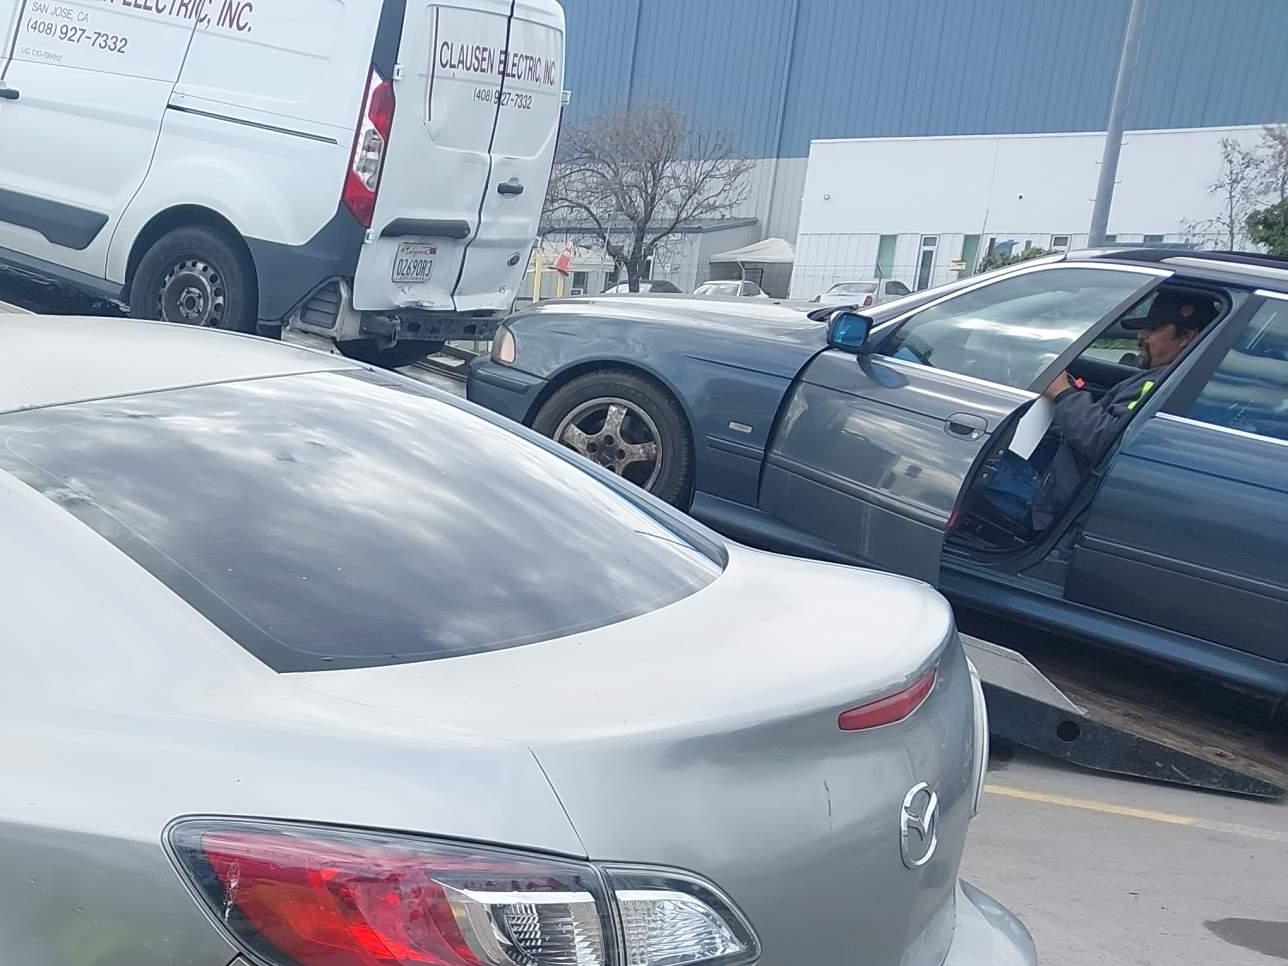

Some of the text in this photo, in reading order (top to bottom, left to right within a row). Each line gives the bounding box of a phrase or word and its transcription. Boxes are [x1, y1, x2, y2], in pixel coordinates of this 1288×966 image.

[32, 1, 49, 14] SAN
[77, 11, 89, 23] CA
[216, 0, 253, 33] INC.
[26, 16, 128, 54] (408) 927-7332
[439, 41, 496, 74] CLAUSEN
[473, 87, 532, 109] (408) 927-7332
